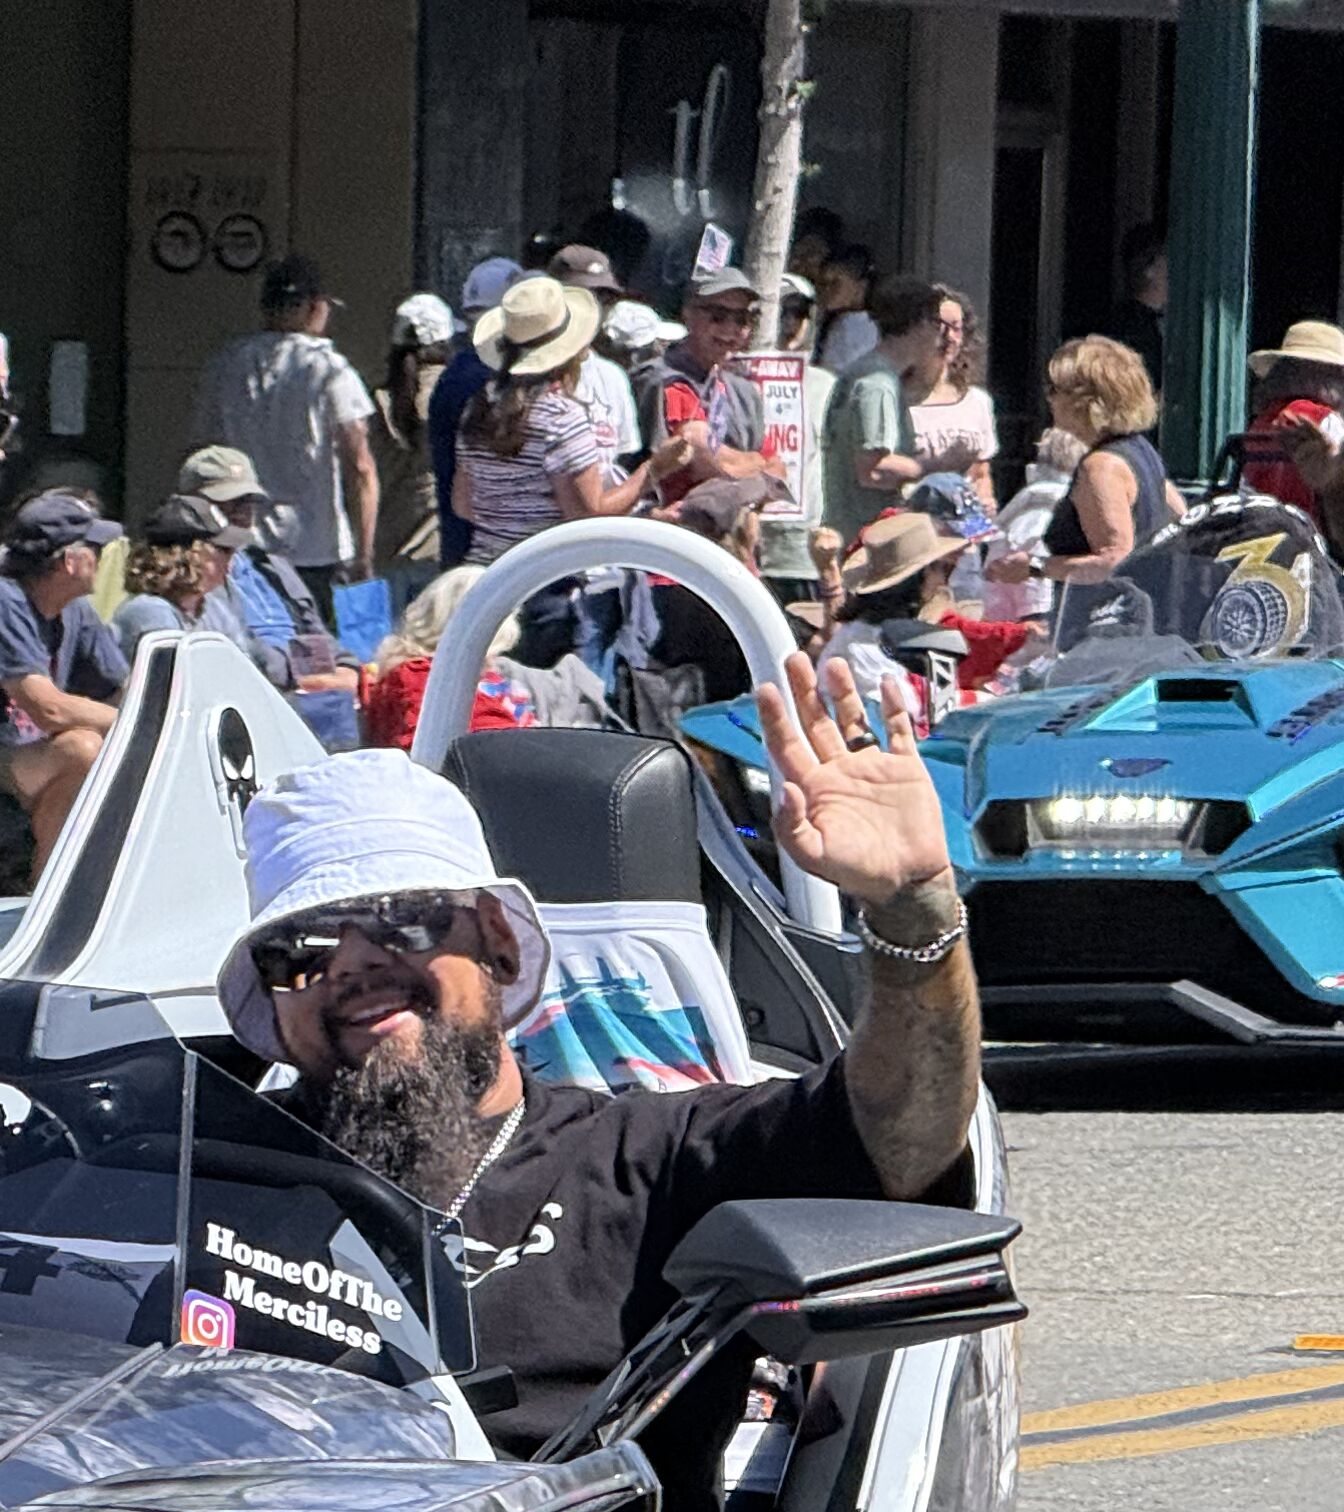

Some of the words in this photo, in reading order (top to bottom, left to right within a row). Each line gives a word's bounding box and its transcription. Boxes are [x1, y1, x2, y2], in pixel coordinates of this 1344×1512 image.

[766, 384, 799, 400] JULY
[205, 1221, 403, 1322] HomeOfThe
[223, 1270, 382, 1355] Merciless
